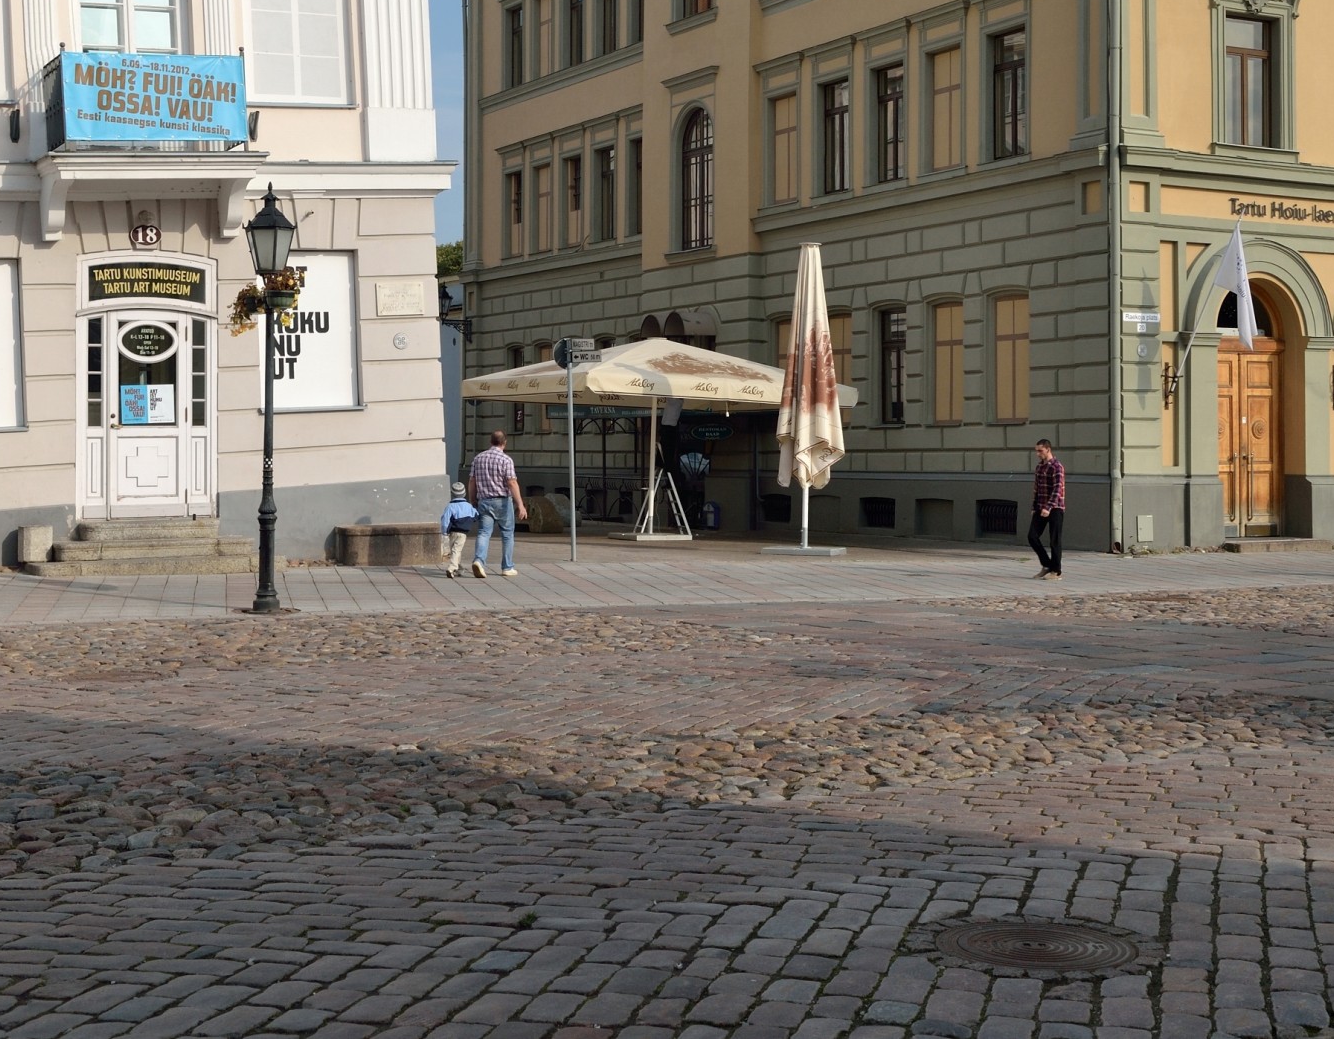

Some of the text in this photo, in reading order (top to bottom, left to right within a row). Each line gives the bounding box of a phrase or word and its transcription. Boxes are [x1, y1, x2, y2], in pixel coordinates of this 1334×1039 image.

[74, 61, 136, 91] MÖH?
[142, 72, 182, 97] FUI!
[97, 90, 213, 122] OSSA! VAU!
[78, 109, 230, 135] Eesti kaasaegse kunsti klassika
[1228, 197, 1267, 217] Tartu
[136, 226, 157, 244] 18
[93, 268, 200, 283] TARTU KUNSTIMUUSEUM
[103, 282, 191, 296] TARTU ART MUSEUM
[273, 335, 301, 356] NU
